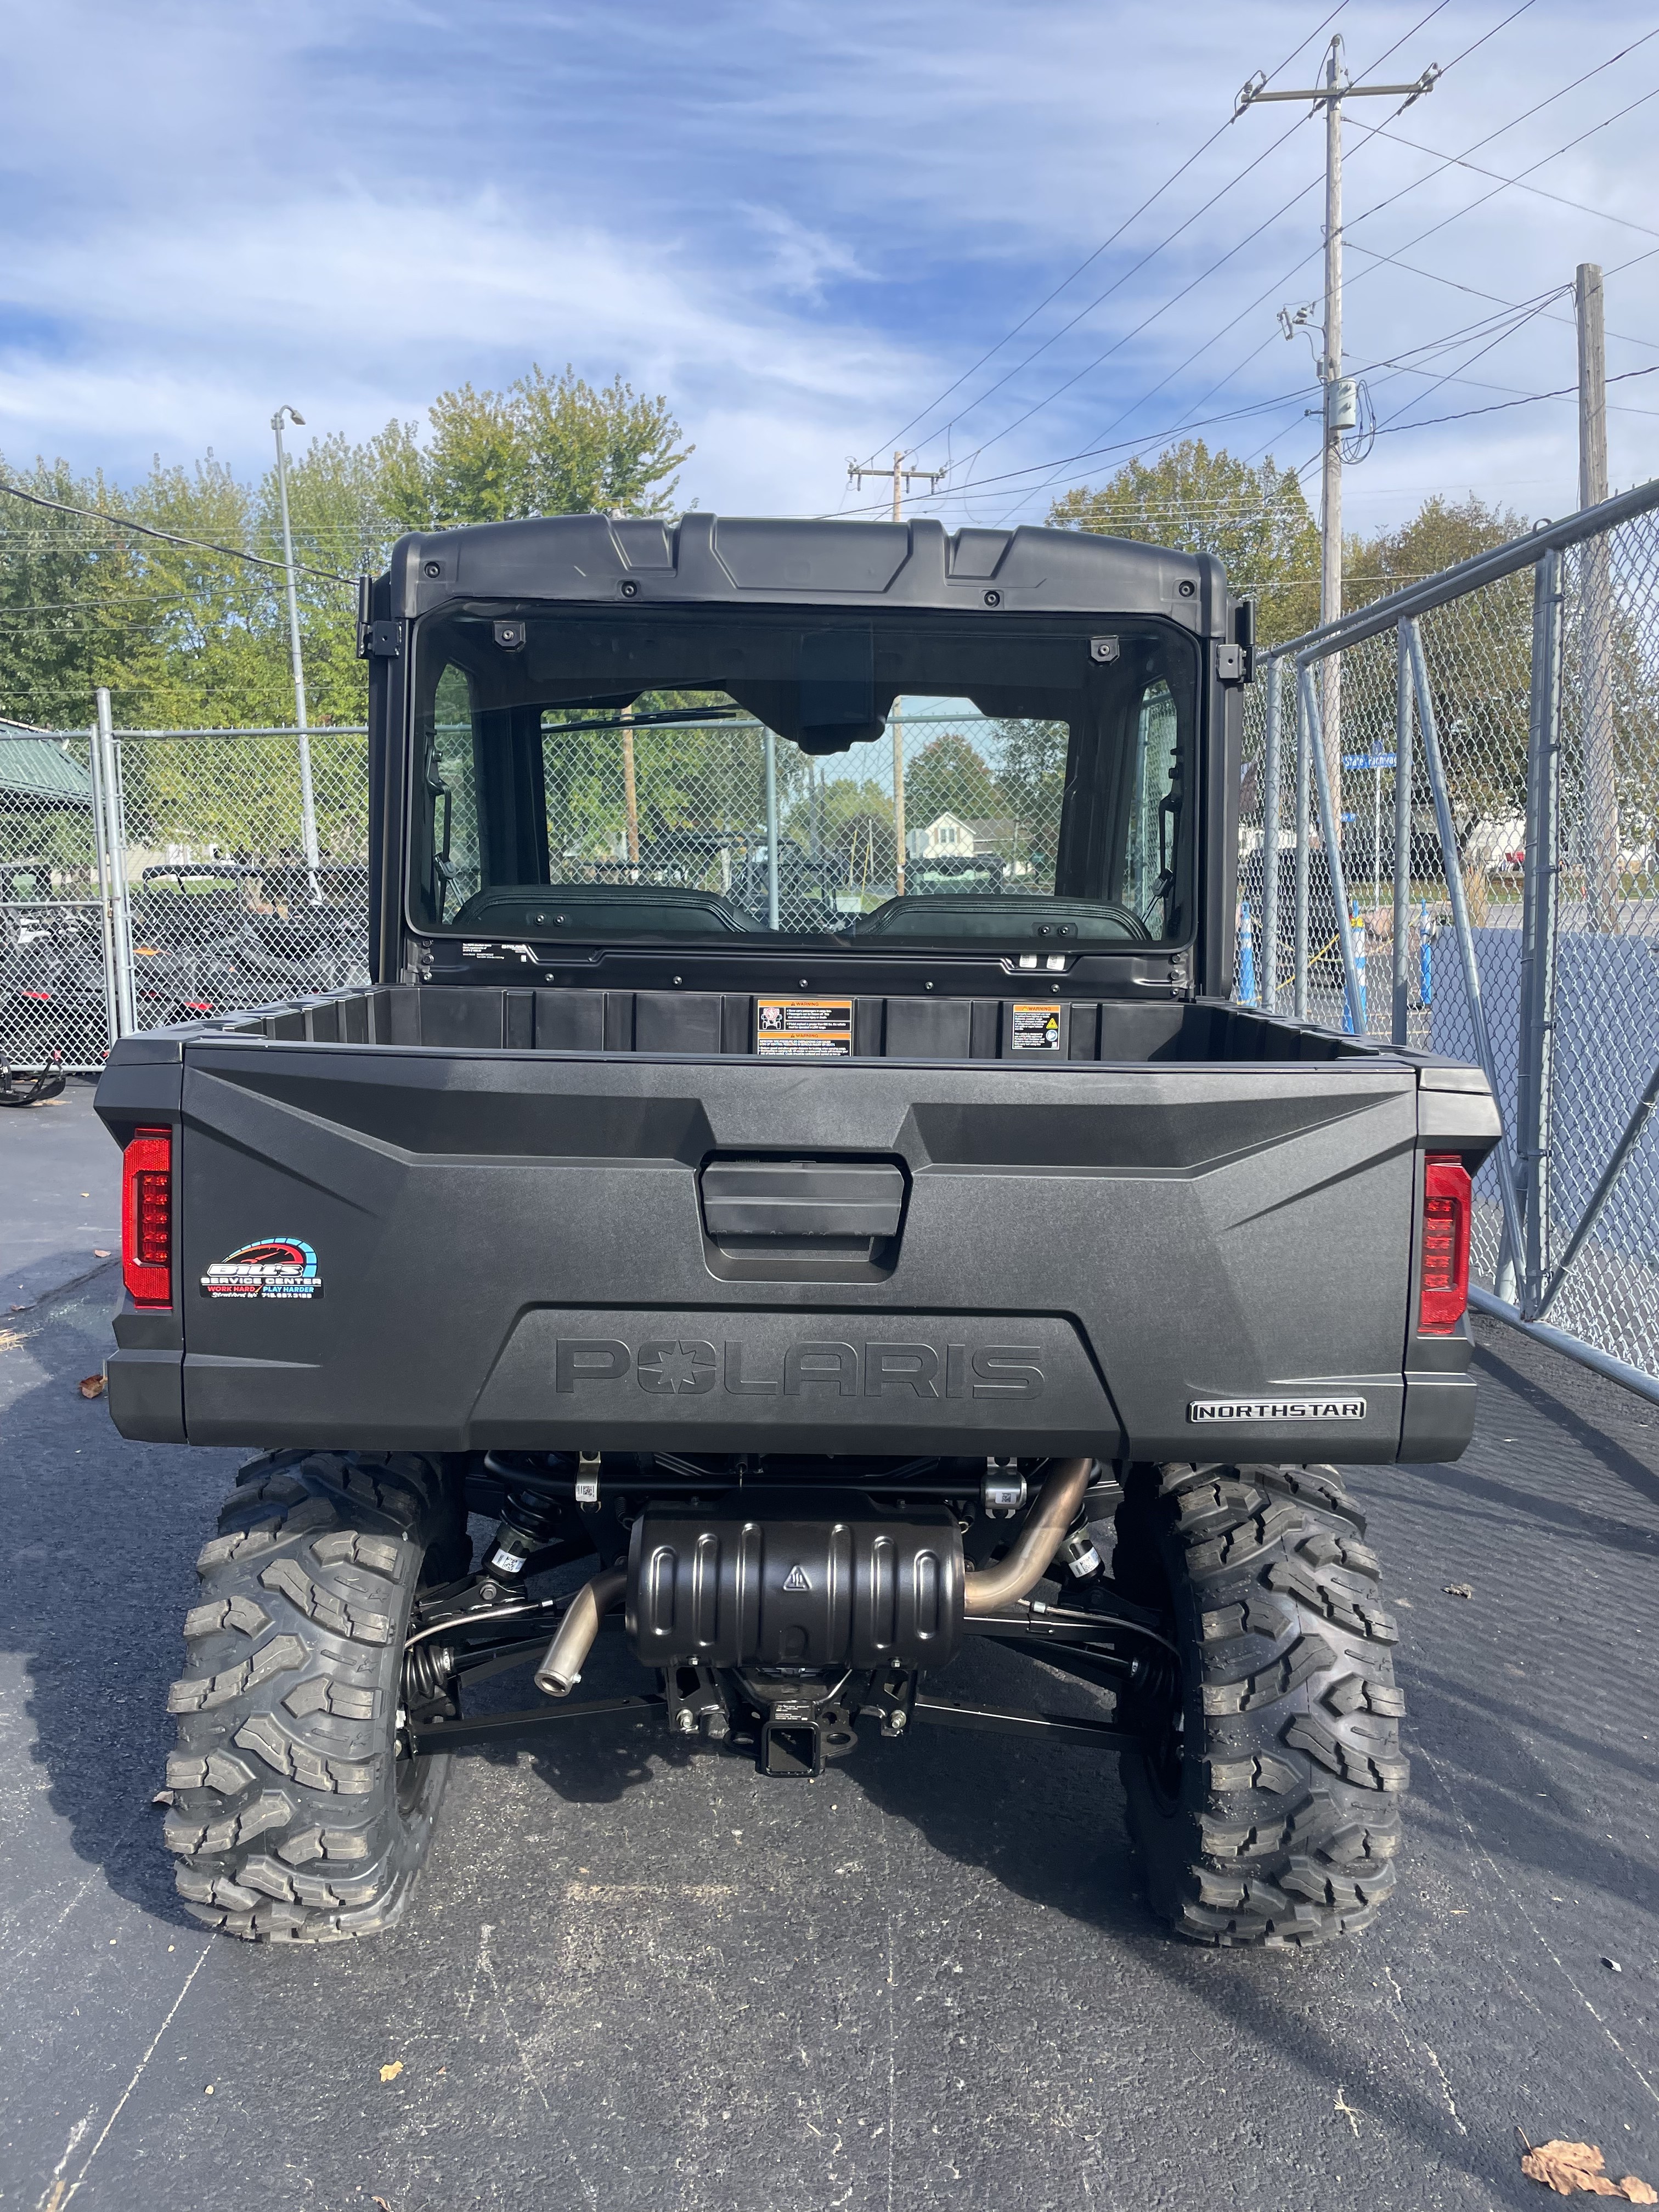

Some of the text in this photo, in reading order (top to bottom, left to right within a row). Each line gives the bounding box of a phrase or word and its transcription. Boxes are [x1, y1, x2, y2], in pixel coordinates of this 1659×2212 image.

[208, 1265, 302, 1276] BILL'S
[556, 1338, 1046, 1400] POLARIS
[1199, 1403, 1358, 1419] NORTHSTAR
